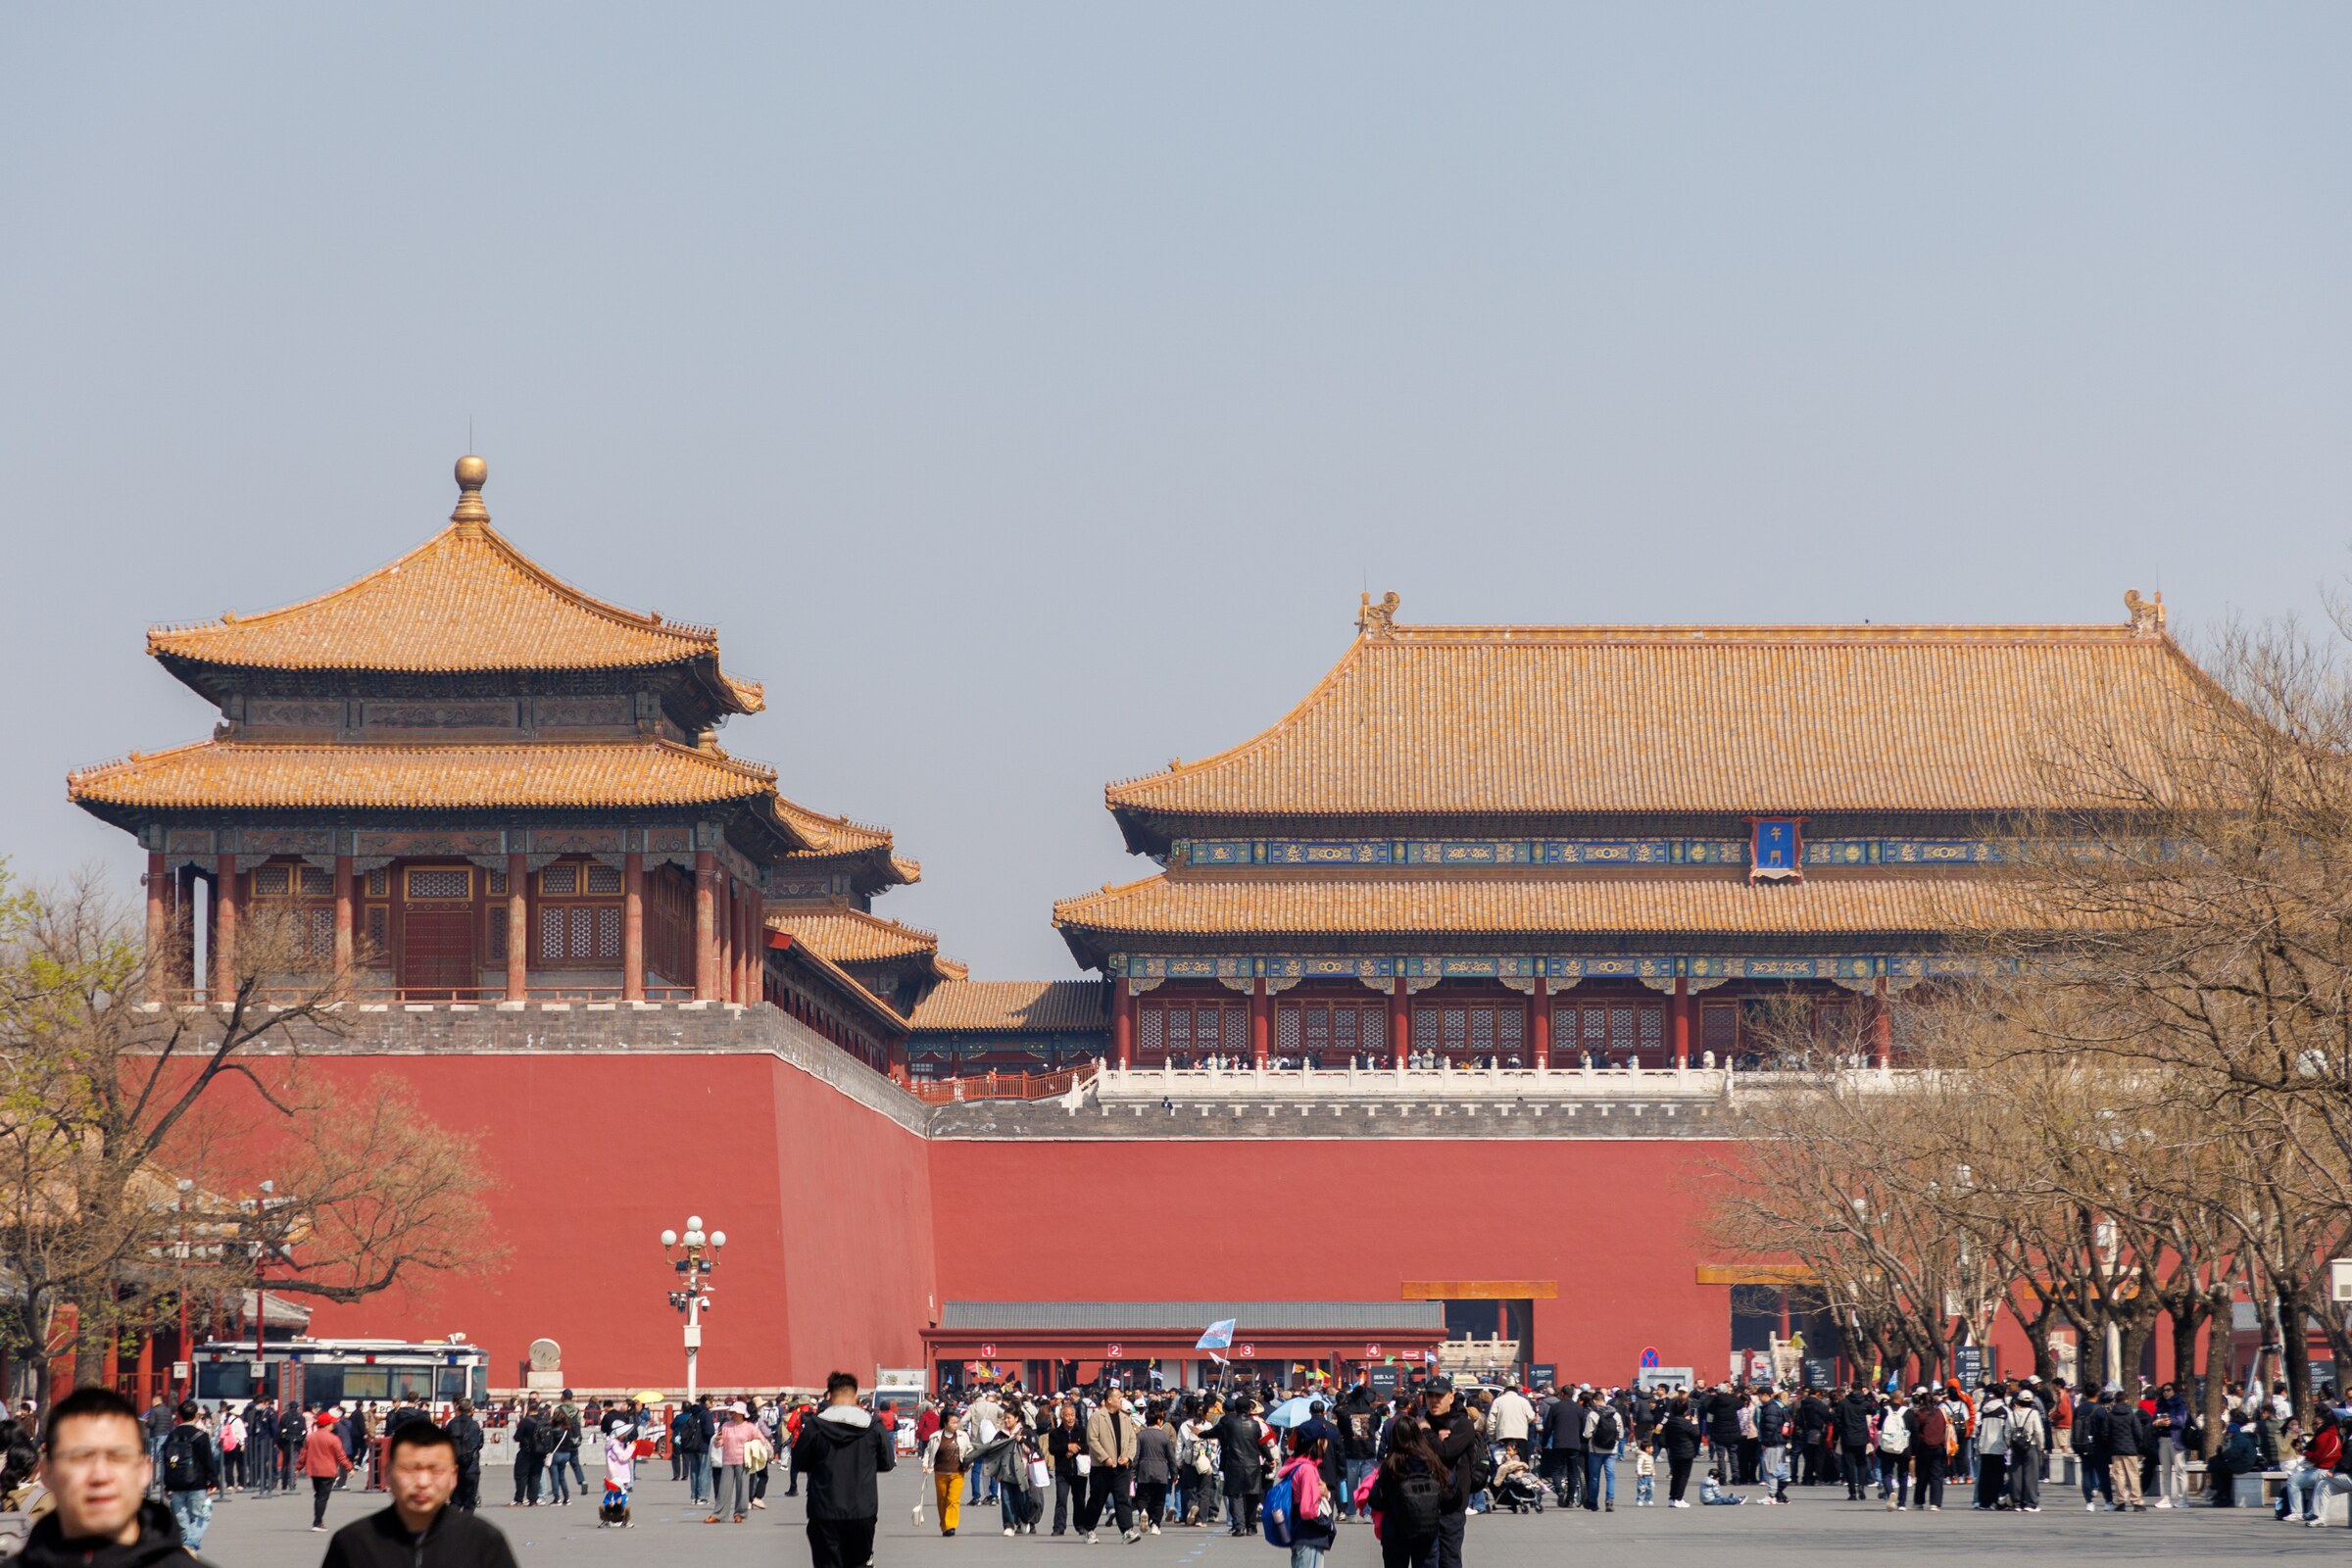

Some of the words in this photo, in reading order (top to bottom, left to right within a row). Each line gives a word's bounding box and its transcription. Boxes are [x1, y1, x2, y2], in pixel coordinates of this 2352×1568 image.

[1770, 826, 1782, 864] 午門
[985, 1346, 991, 1355] 1
[1111, 1346, 1119, 1355] 2
[1244, 1346, 1251, 1355] 3
[1369, 1346, 1378, 1355] 4
